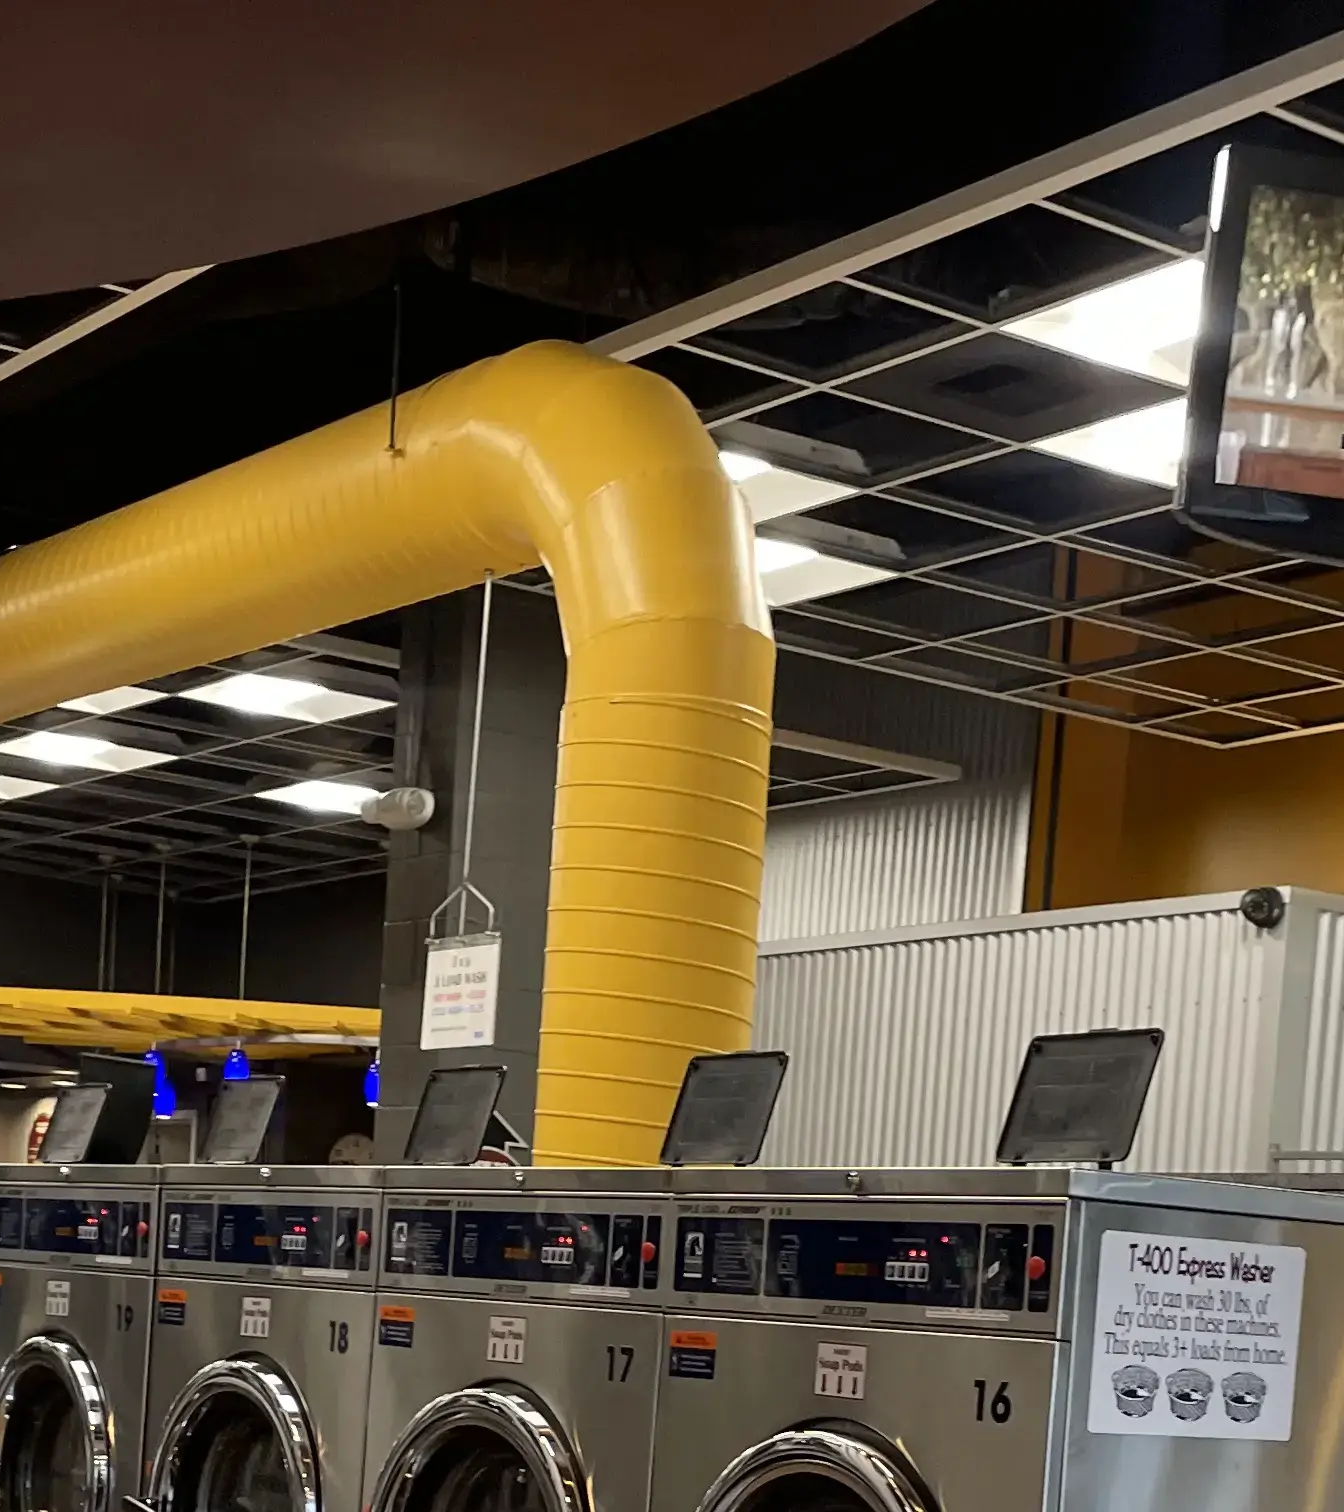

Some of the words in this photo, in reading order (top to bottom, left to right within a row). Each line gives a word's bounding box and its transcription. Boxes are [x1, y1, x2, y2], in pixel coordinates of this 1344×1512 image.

[1129, 1244, 1173, 1275] T-400
[1177, 1247, 1226, 1284] Express
[1230, 1252, 1275, 1283] Washer
[116, 1303, 133, 1331] 19
[1135, 1283, 1159, 1307] You
[1162, 1292, 1182, 1308] can
[1186, 1289, 1214, 1310] wash
[1256, 1294, 1271, 1318] of
[1114, 1305, 1134, 1333] dry
[1137, 1307, 1177, 1330] clothes
[1180, 1316, 1191, 1331] in
[1195, 1311, 1223, 1333] these
[329, 1320, 348, 1354] 18
[1105, 1332, 1129, 1354] This
[1132, 1336, 1169, 1362] equals
[1190, 1338, 1221, 1360] loads
[1223, 1340, 1251, 1362] from
[606, 1345, 634, 1382] 17
[974, 1379, 1013, 1424] 16
